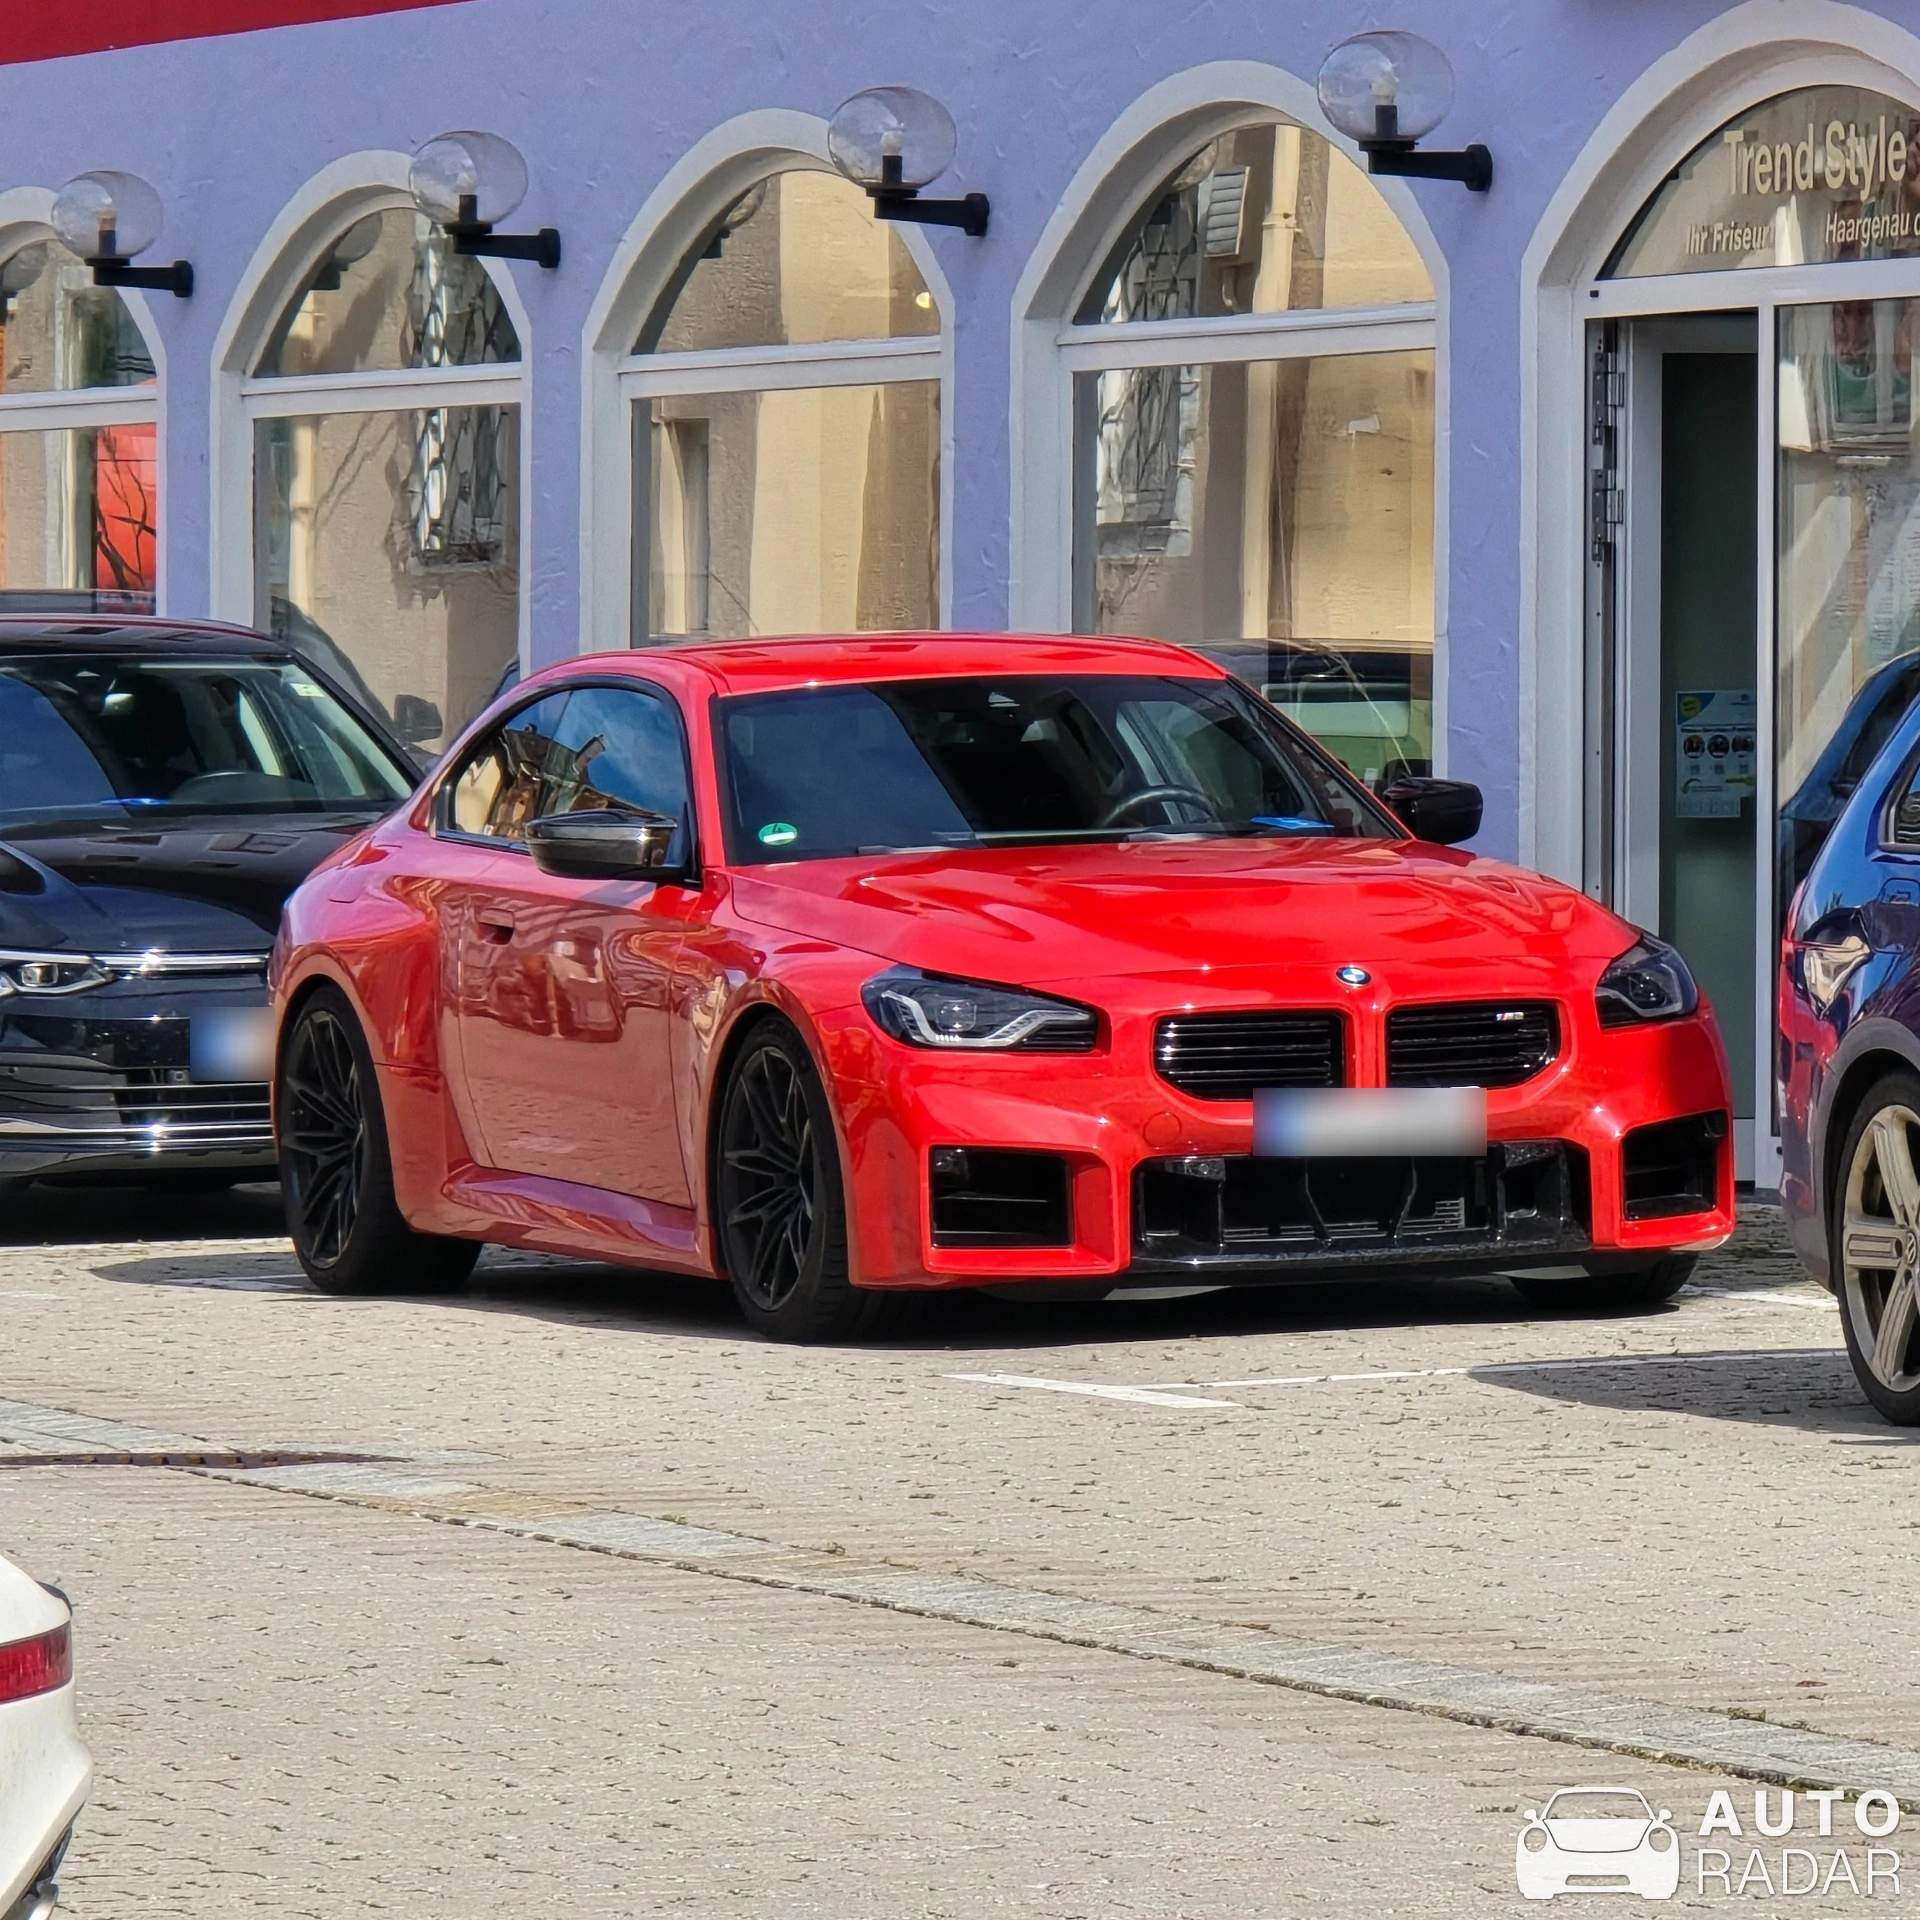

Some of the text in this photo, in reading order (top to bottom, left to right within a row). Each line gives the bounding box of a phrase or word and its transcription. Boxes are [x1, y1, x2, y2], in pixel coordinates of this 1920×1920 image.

[1723, 115, 1907, 202] Trend Style
[1686, 220, 1770, 255] Ihr Friseur
[1825, 210, 1910, 248] Haargenau
